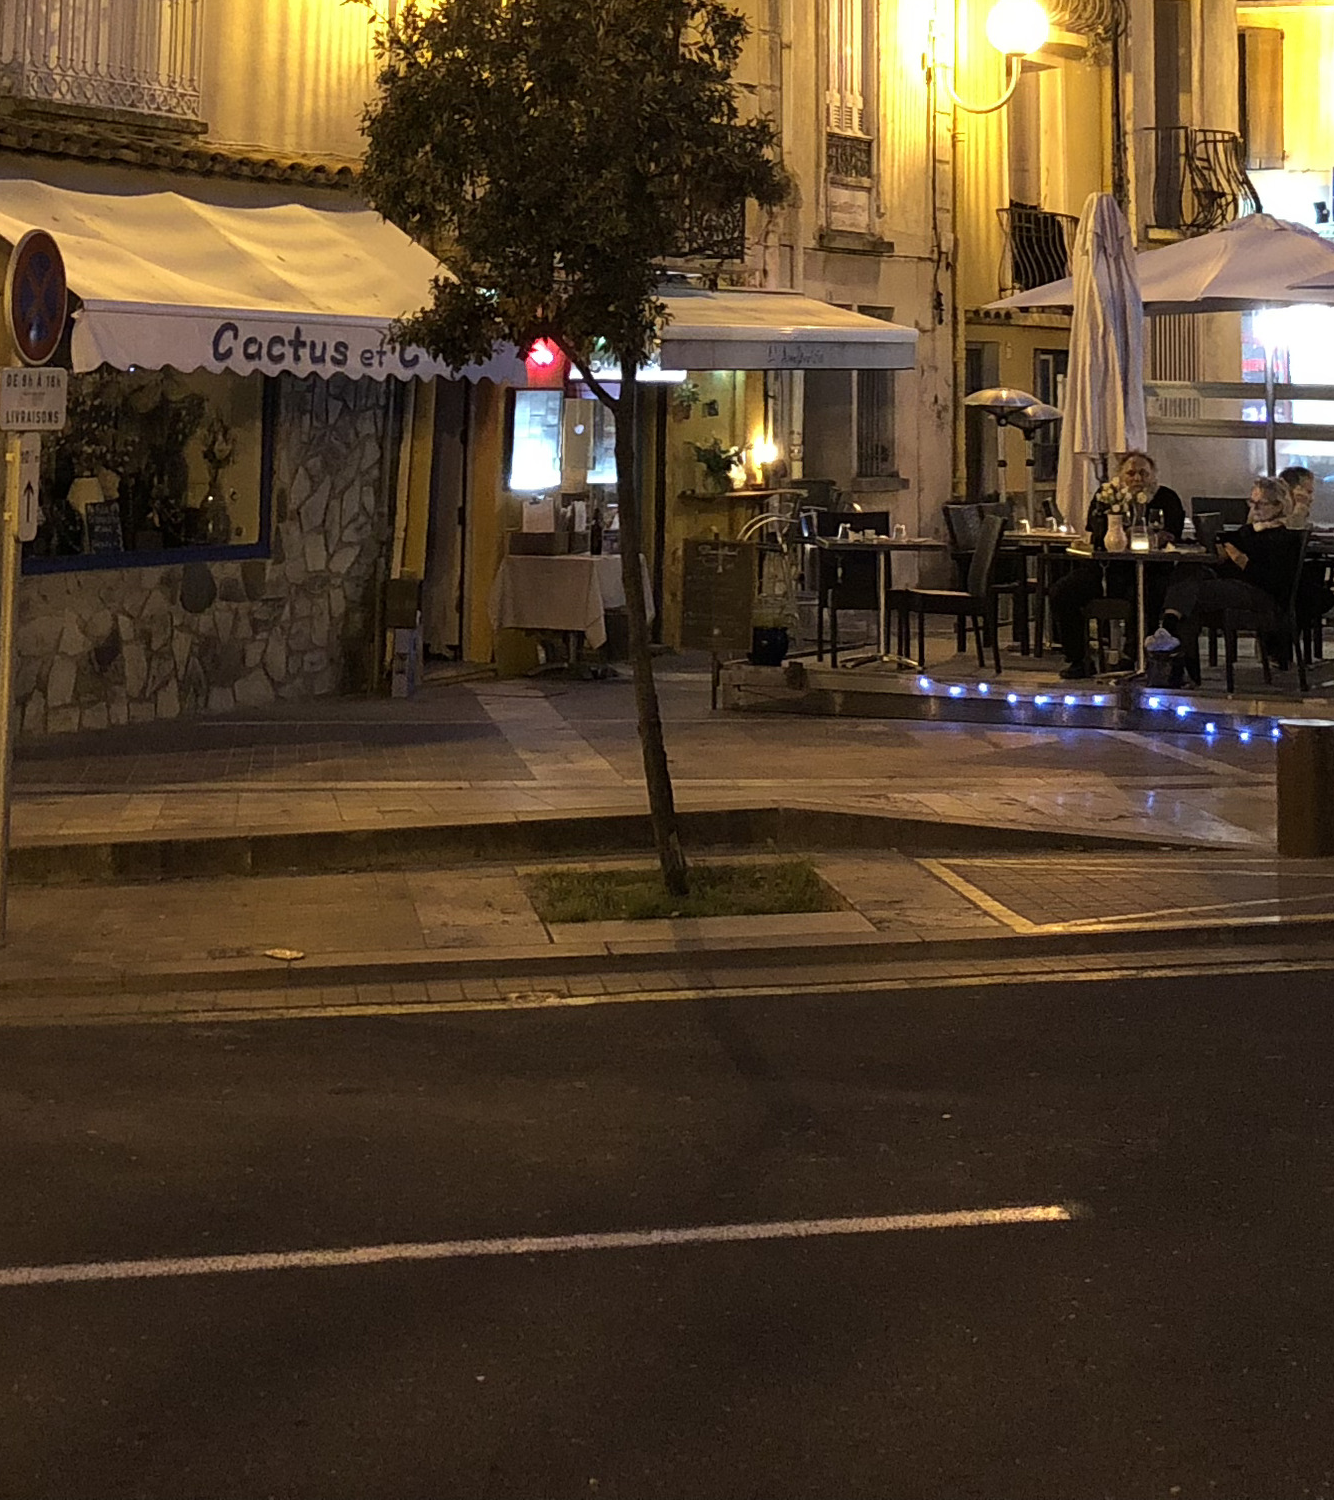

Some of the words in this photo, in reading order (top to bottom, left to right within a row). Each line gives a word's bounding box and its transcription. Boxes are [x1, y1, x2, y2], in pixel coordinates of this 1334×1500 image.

[211, 321, 350, 366] Cactus
[6, 373, 19, 388] DE
[5, 410, 60, 425] LIVRAISONS
